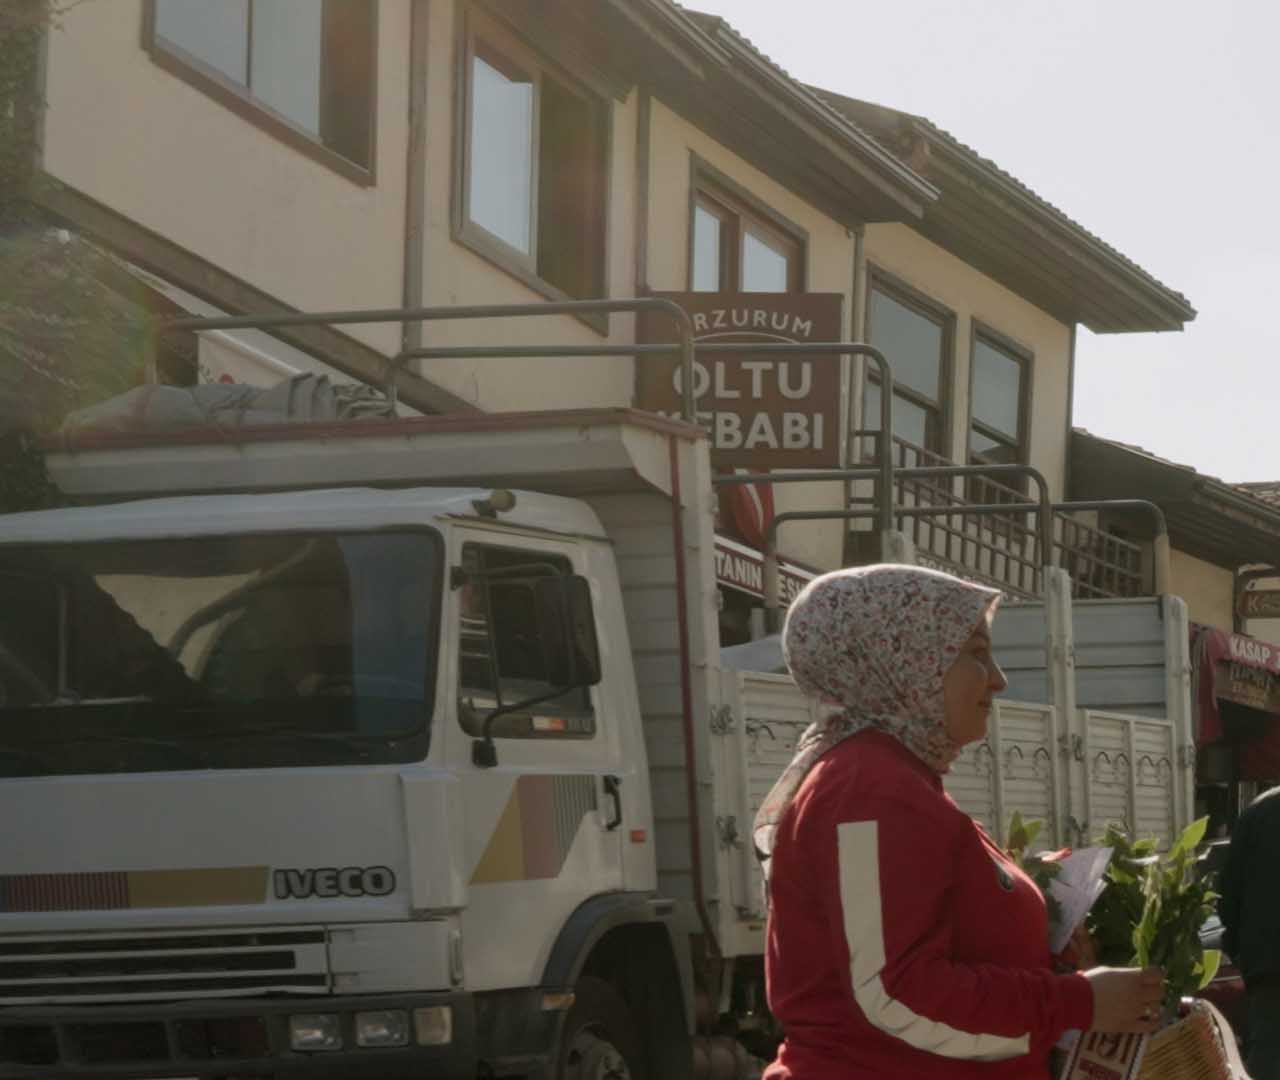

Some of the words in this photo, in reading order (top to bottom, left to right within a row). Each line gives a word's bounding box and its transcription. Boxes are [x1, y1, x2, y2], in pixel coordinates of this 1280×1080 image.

[688, 309, 813, 337] RZURUM
[673, 361, 812, 399] OLTU
[658, 411, 824, 449] EBABI
[1229, 636, 1271, 665] KASAP
[273, 865, 396, 899] IVECO
